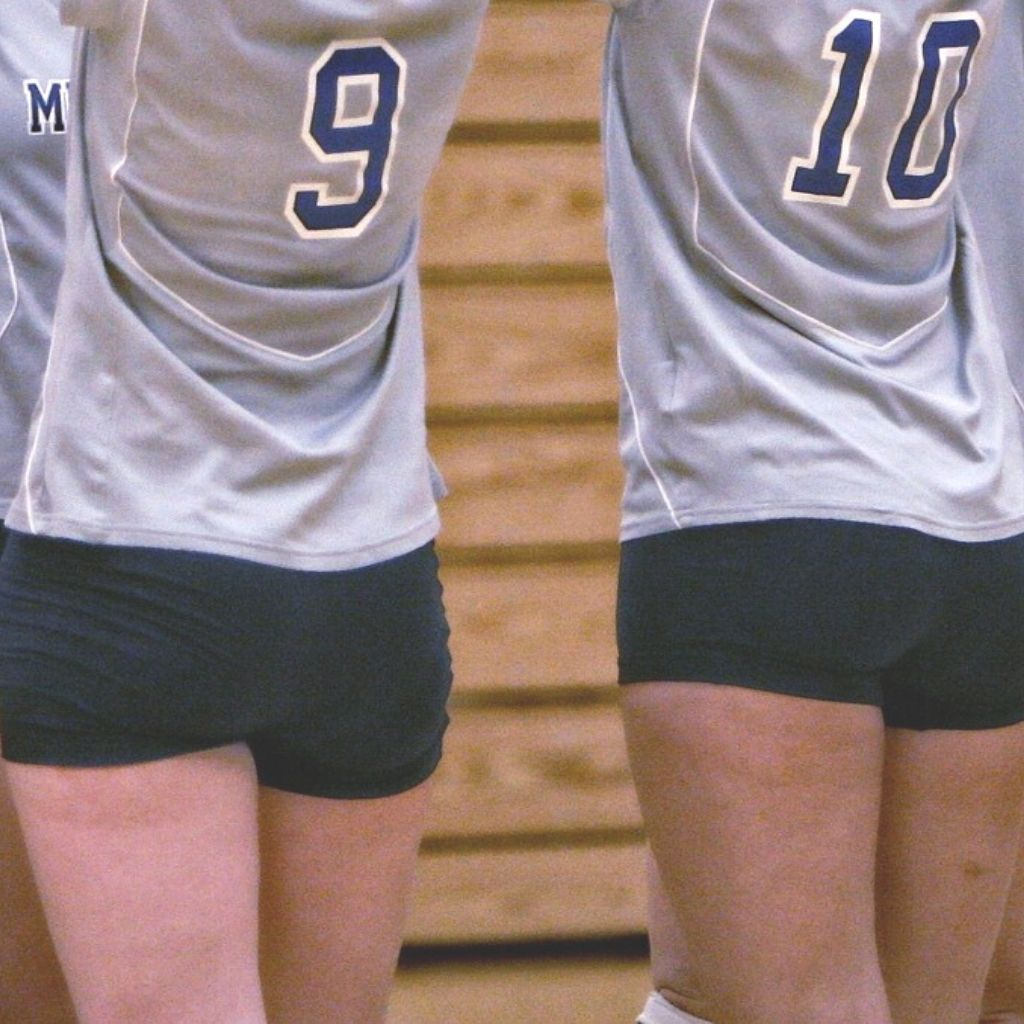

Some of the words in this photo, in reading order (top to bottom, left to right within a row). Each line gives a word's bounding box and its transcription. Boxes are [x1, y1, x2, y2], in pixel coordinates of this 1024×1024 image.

[23, 79, 70, 135] M
[284, 38, 407, 239] 9
[783, 9, 985, 209] 10
